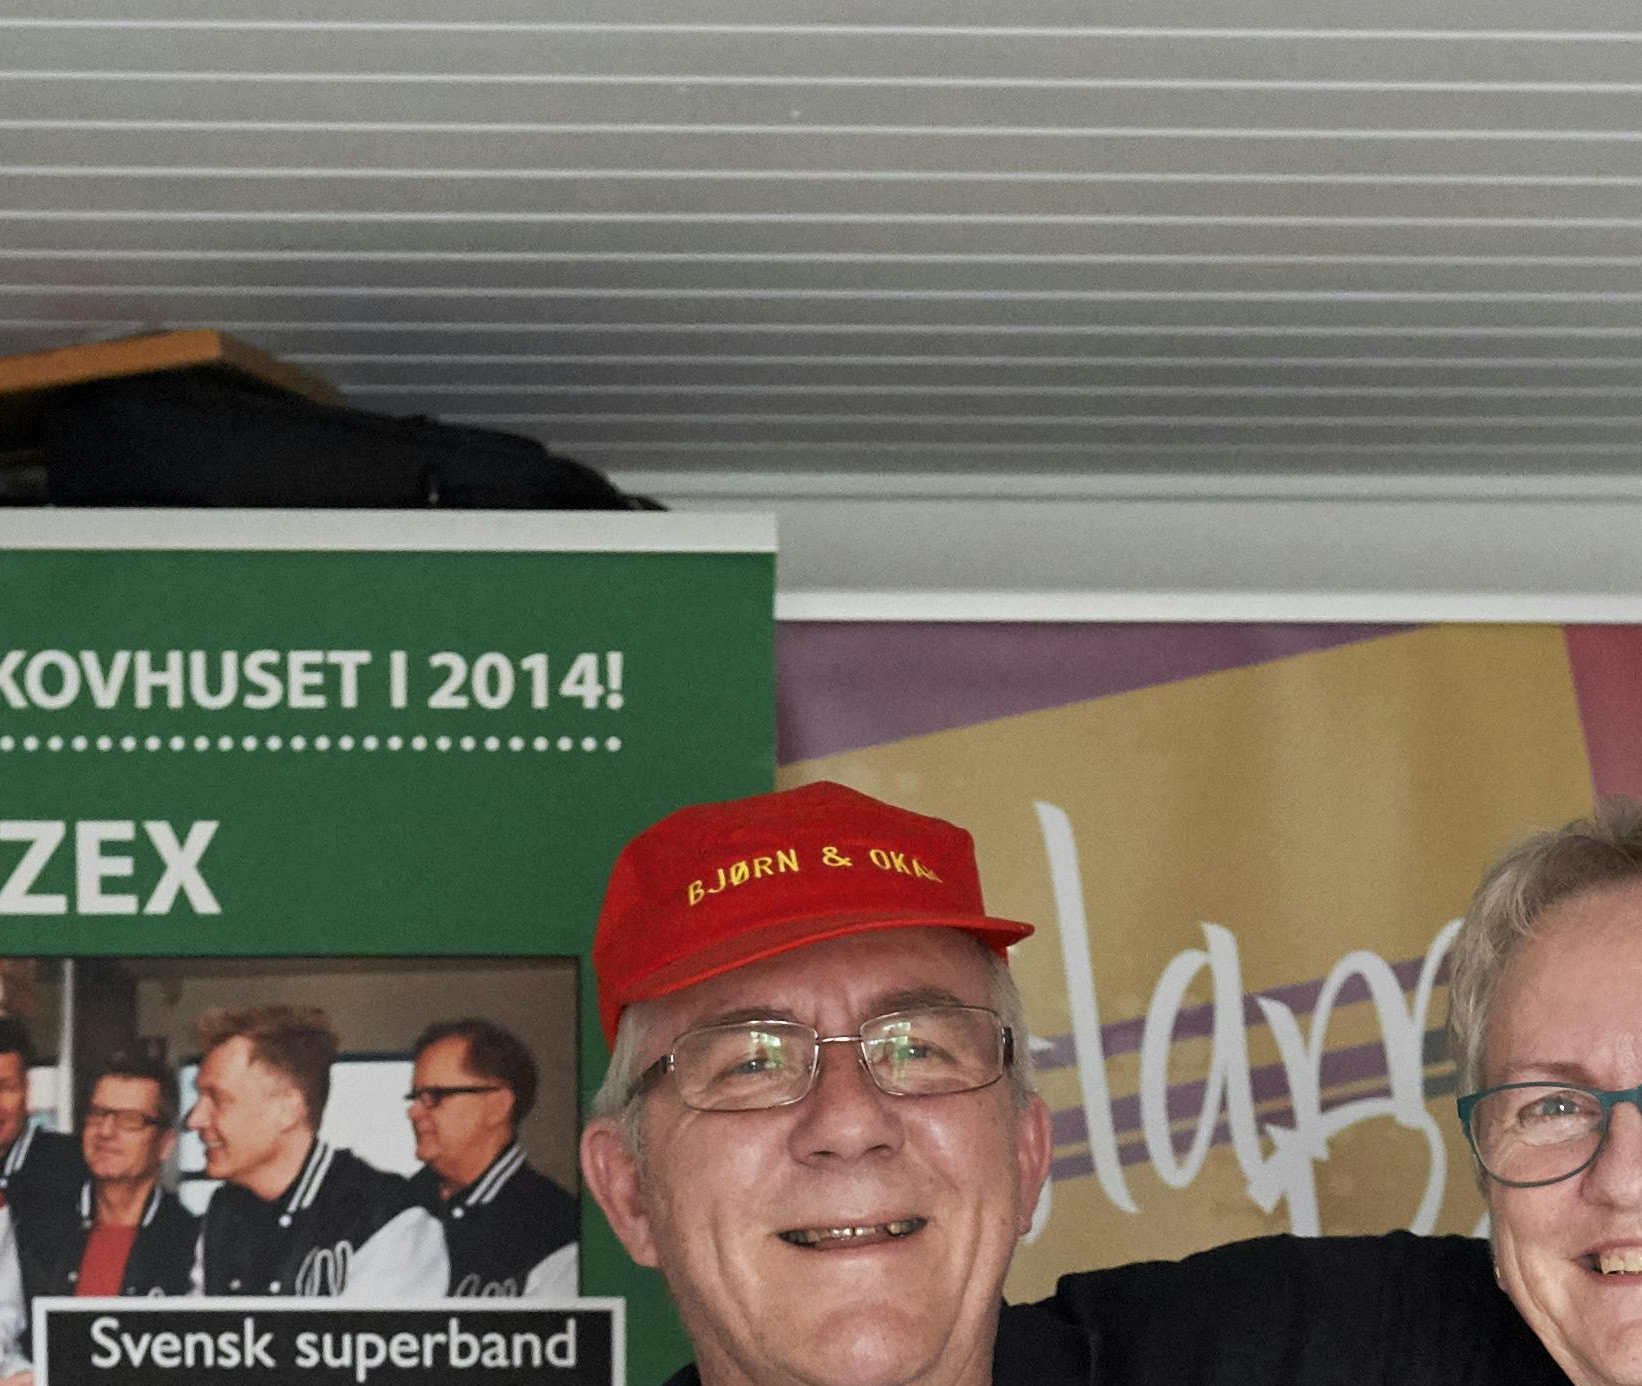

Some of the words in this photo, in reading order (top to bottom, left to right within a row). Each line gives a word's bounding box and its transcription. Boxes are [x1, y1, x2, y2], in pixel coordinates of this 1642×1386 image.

[388, 651, 407, 709] I
[427, 651, 625, 711] 2014!
[687, 848, 800, 906] BJØRN
[821, 846, 853, 867] &
[89, 1316, 276, 1369] Svensk
[295, 1316, 578, 1384] superband
